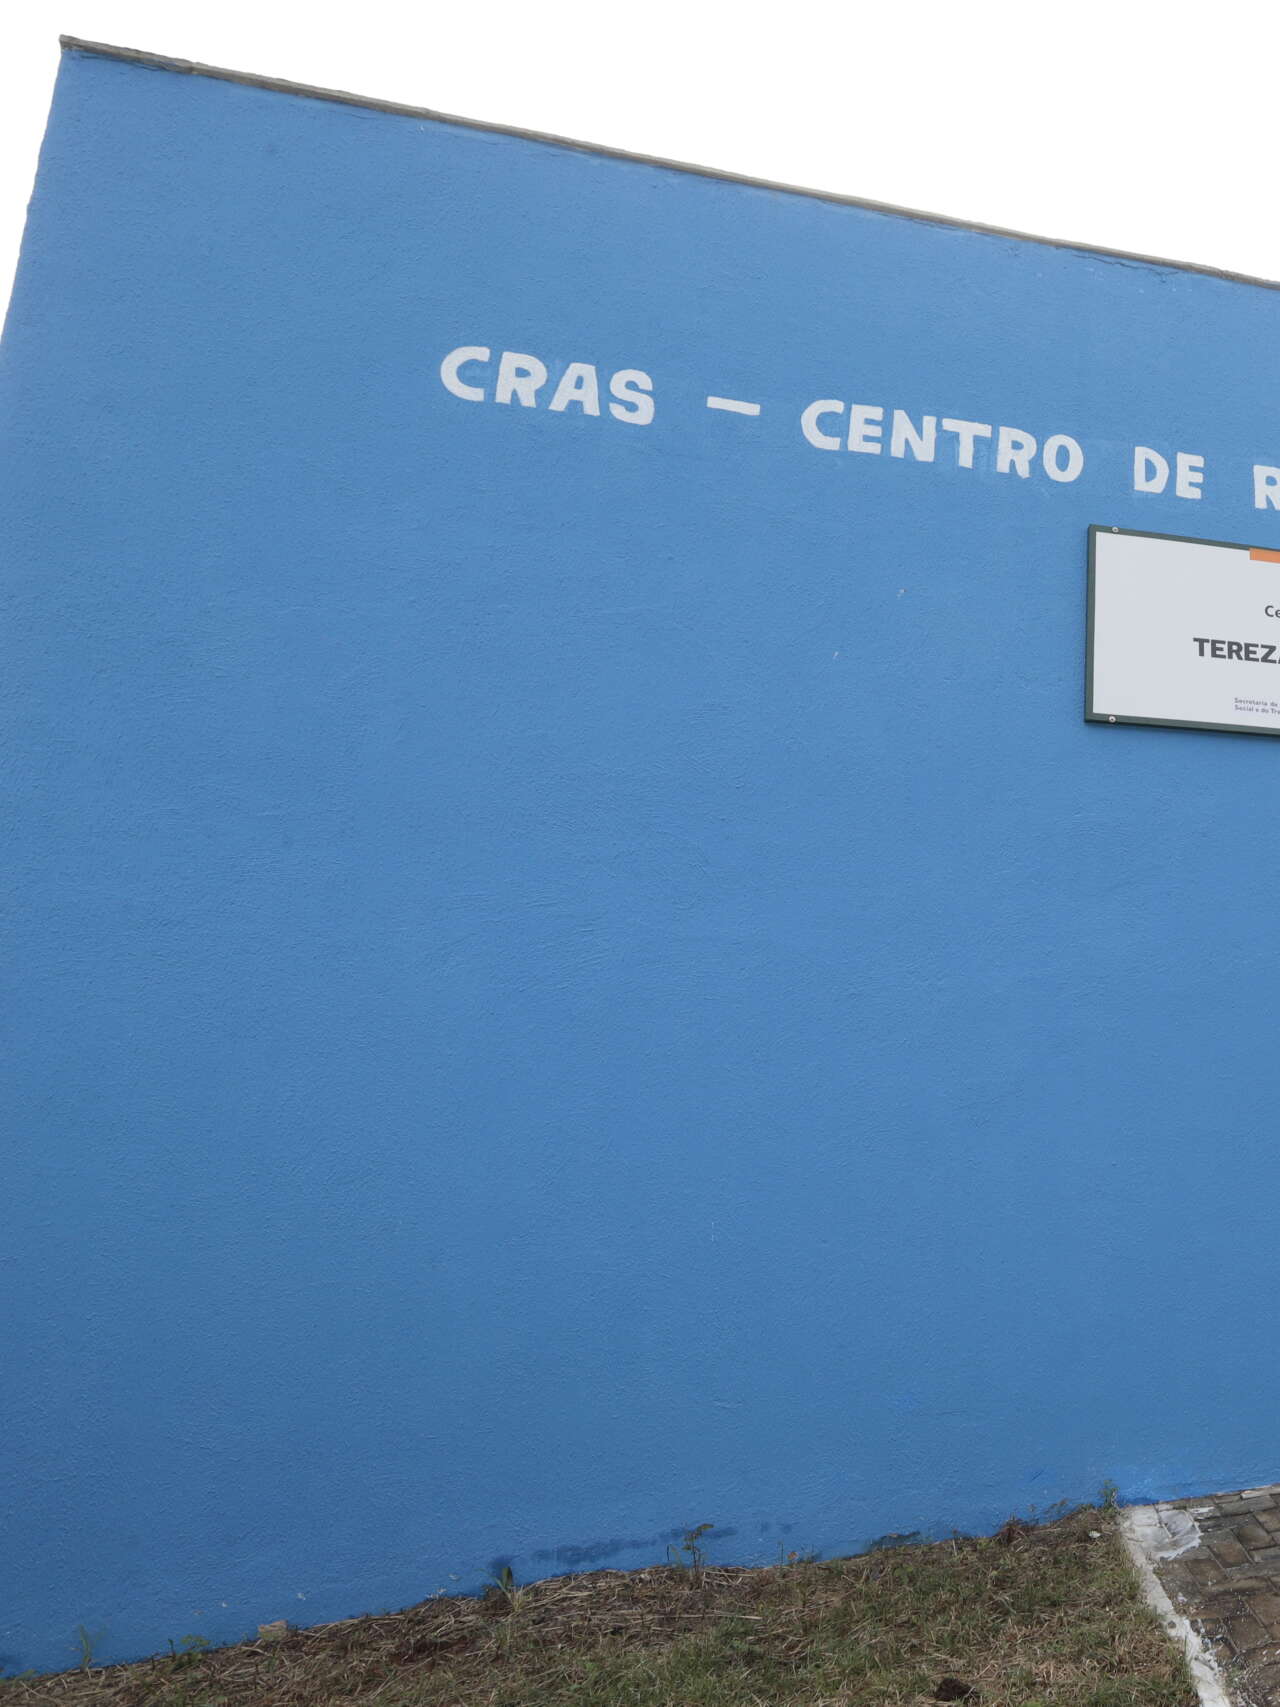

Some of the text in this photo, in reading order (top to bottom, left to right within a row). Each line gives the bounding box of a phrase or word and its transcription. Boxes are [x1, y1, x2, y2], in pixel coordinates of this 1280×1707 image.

[440, 345, 656, 427] CRAS
[800, 399, 1086, 484] CENTRO
[1132, 445, 1207, 500] DE
[1234, 697, 1268, 707] Secretaria
[1234, 704, 1254, 712] Social
